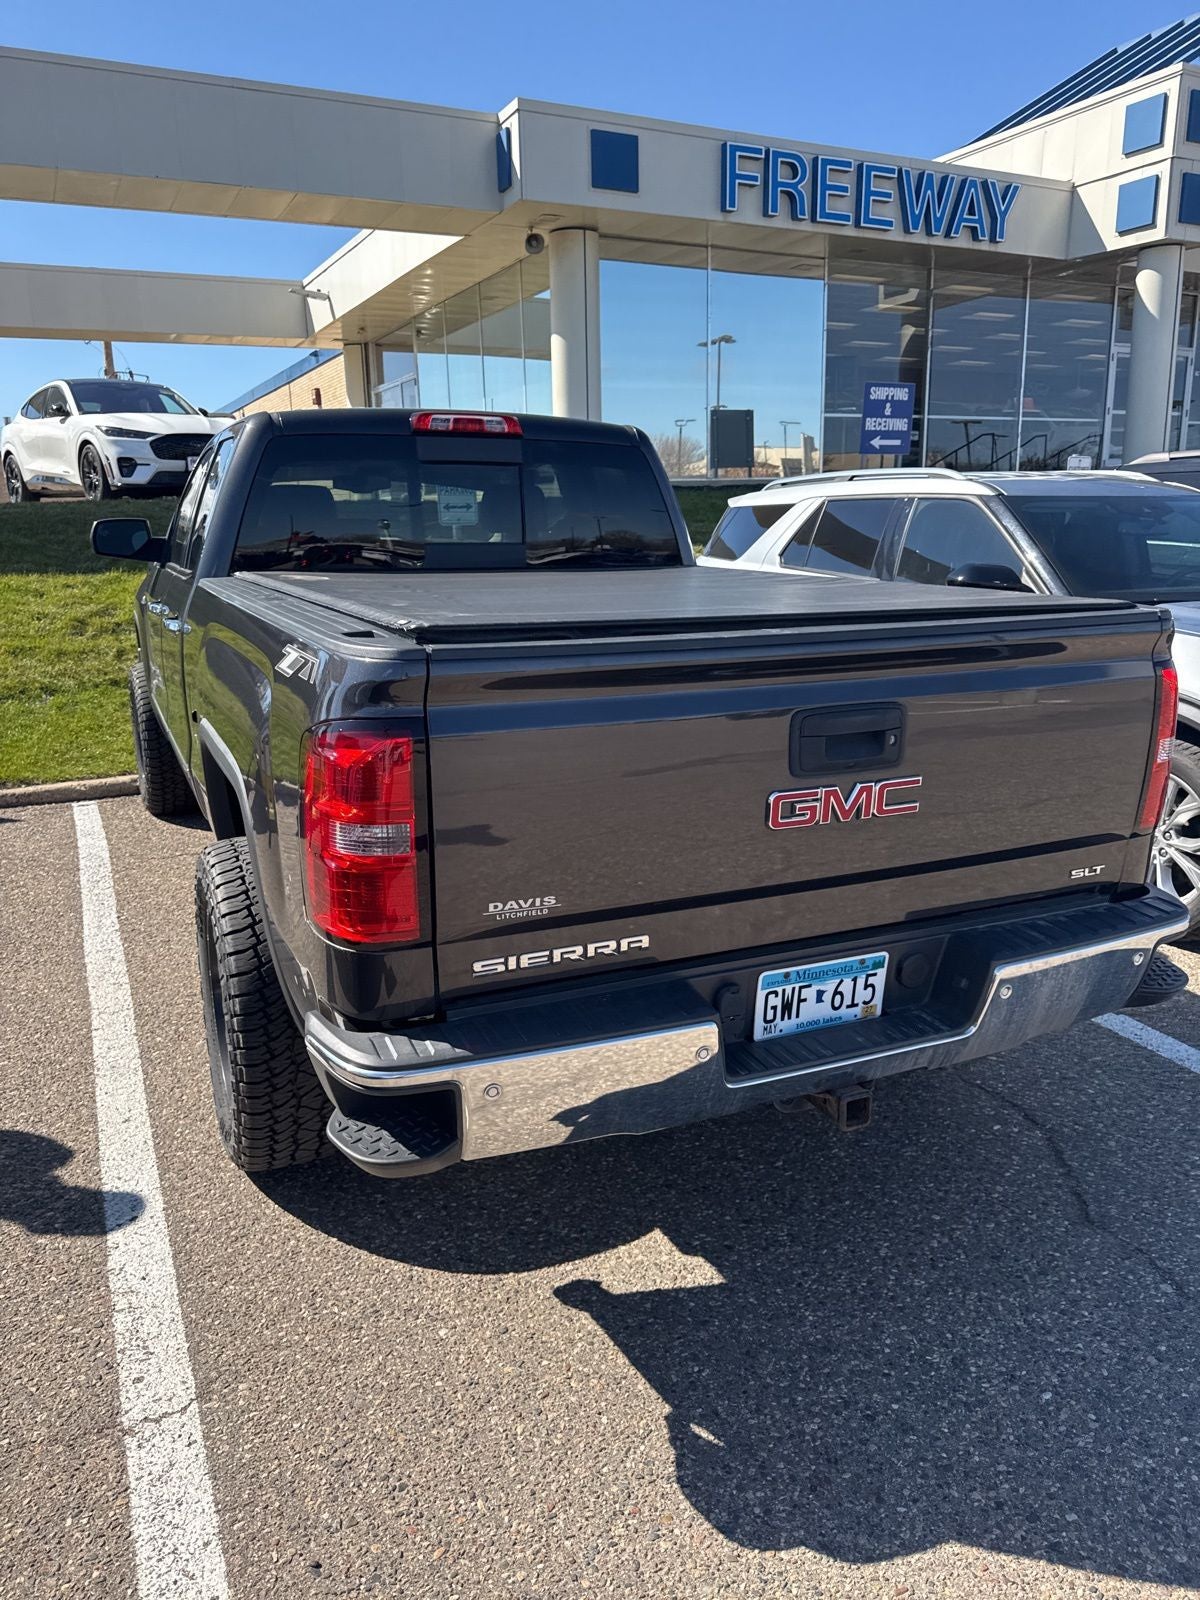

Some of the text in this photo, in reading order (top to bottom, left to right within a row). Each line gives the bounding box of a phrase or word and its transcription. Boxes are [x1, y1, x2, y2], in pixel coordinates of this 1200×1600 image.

[721, 141, 1021, 243] FREEWAY
[869, 386, 909, 401] SHIPPING
[884, 402, 892, 416] &
[865, 417, 909, 431] RECEIVING
[767, 775, 923, 830] GMC
[1070, 864, 1106, 879] SLT
[488, 895, 557, 912] DAVIS
[496, 908, 549, 921] LITCHFIELD
[472, 934, 651, 979] SIERRA
[763, 972, 878, 1025] GWF 615
[762, 1015, 843, 1036] MAY 10,000 lakes
